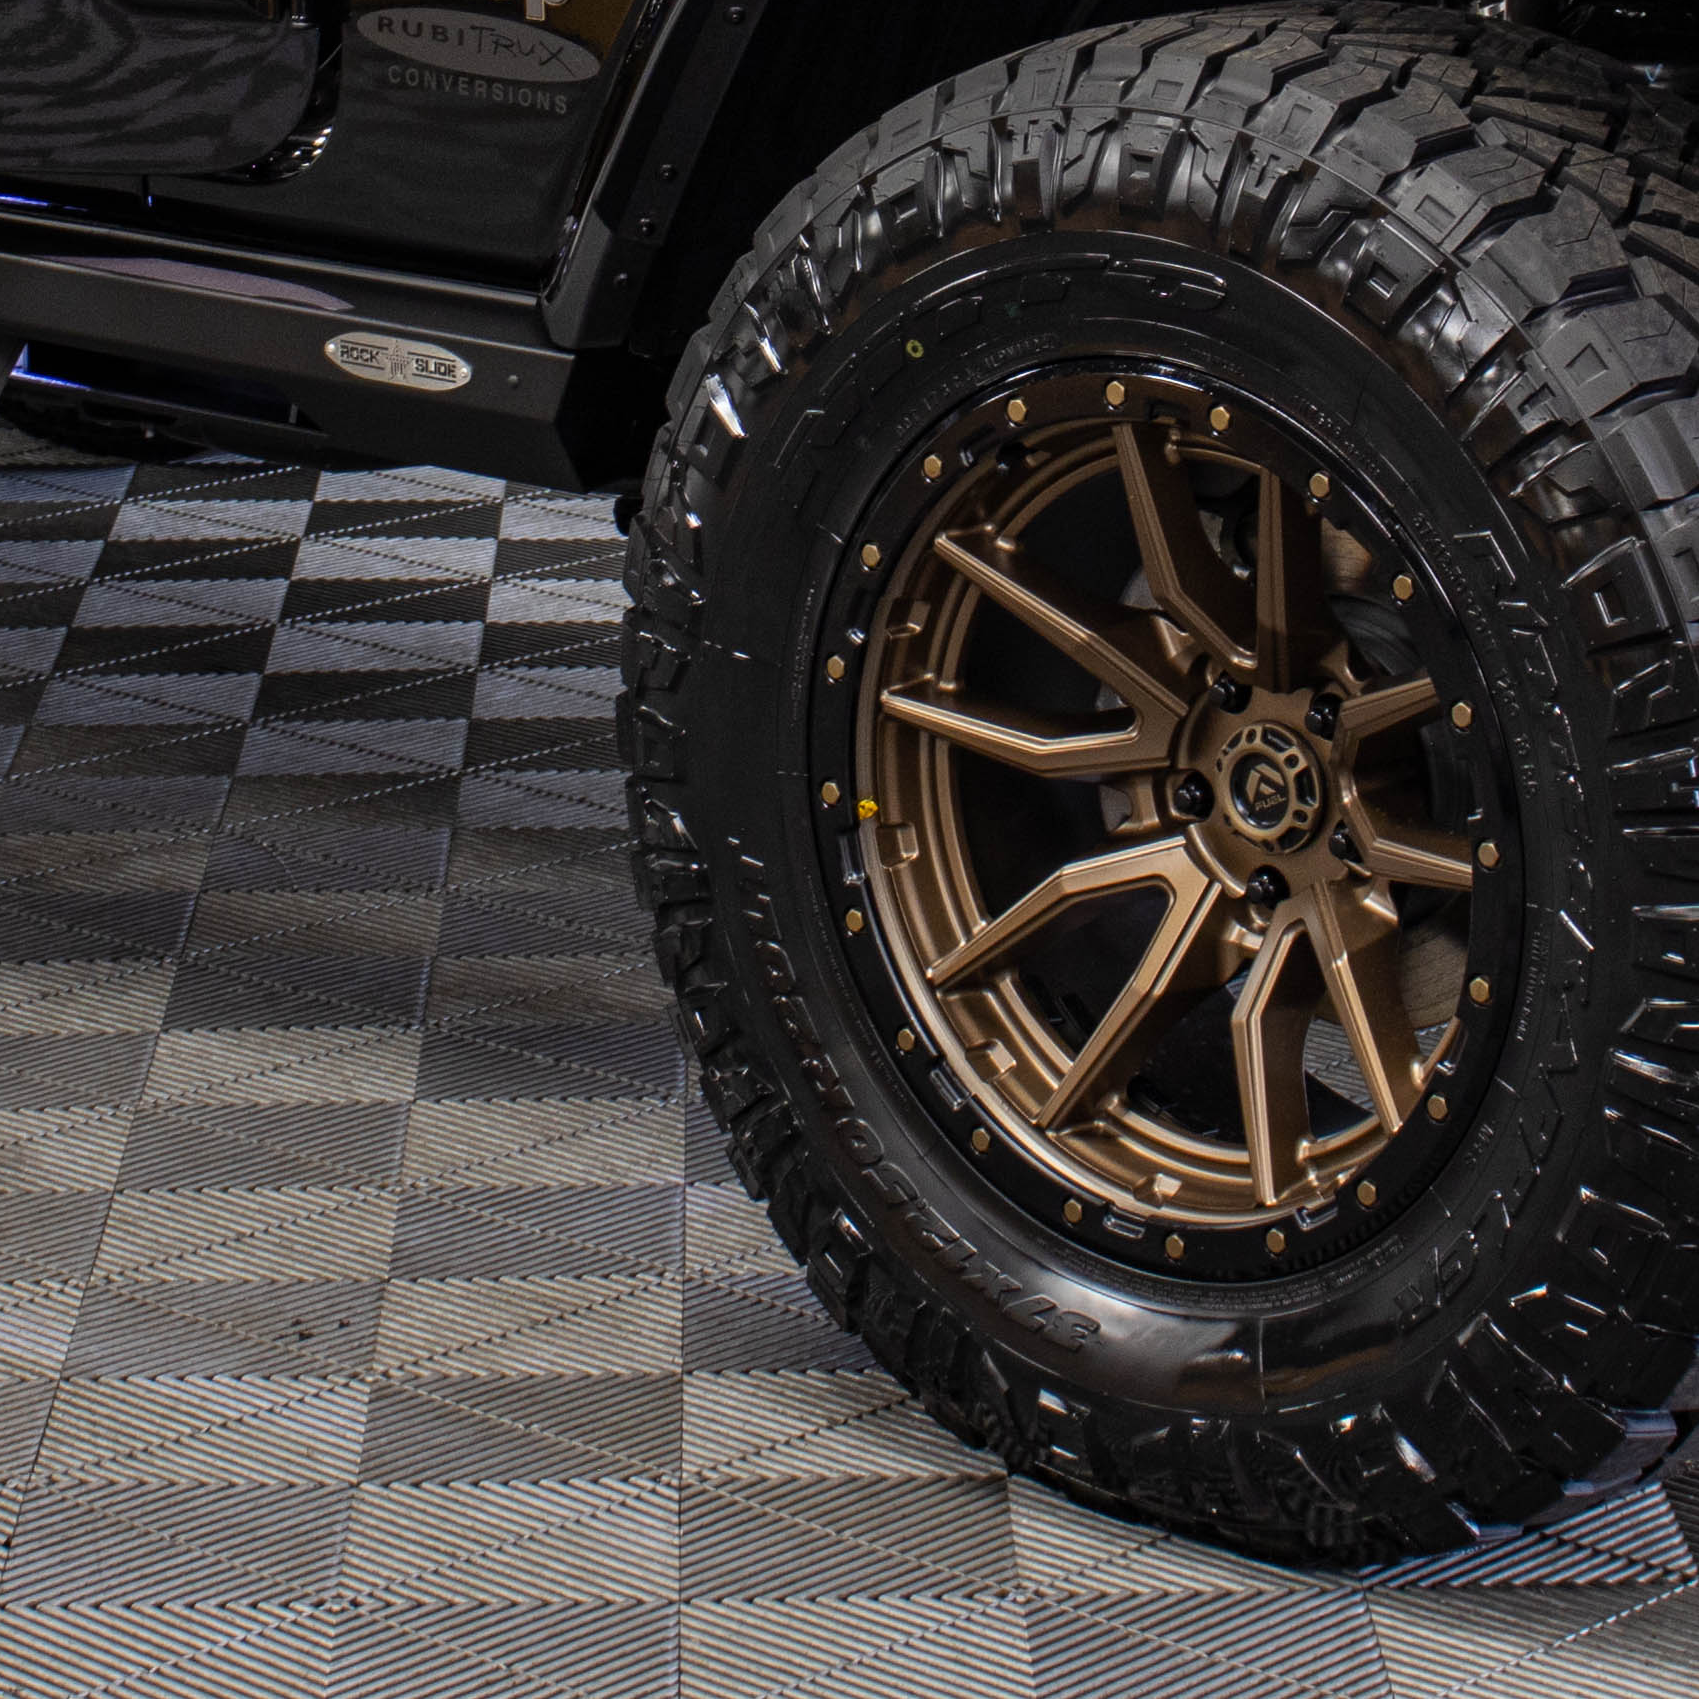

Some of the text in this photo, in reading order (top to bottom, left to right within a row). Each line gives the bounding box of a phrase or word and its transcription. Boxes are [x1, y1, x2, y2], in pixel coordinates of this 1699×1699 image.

[387, 63, 568, 115] CONVERSIONS
[340, 344, 457, 379] ROCK SLIDE
[1255, 793, 1288, 812] FUEL
